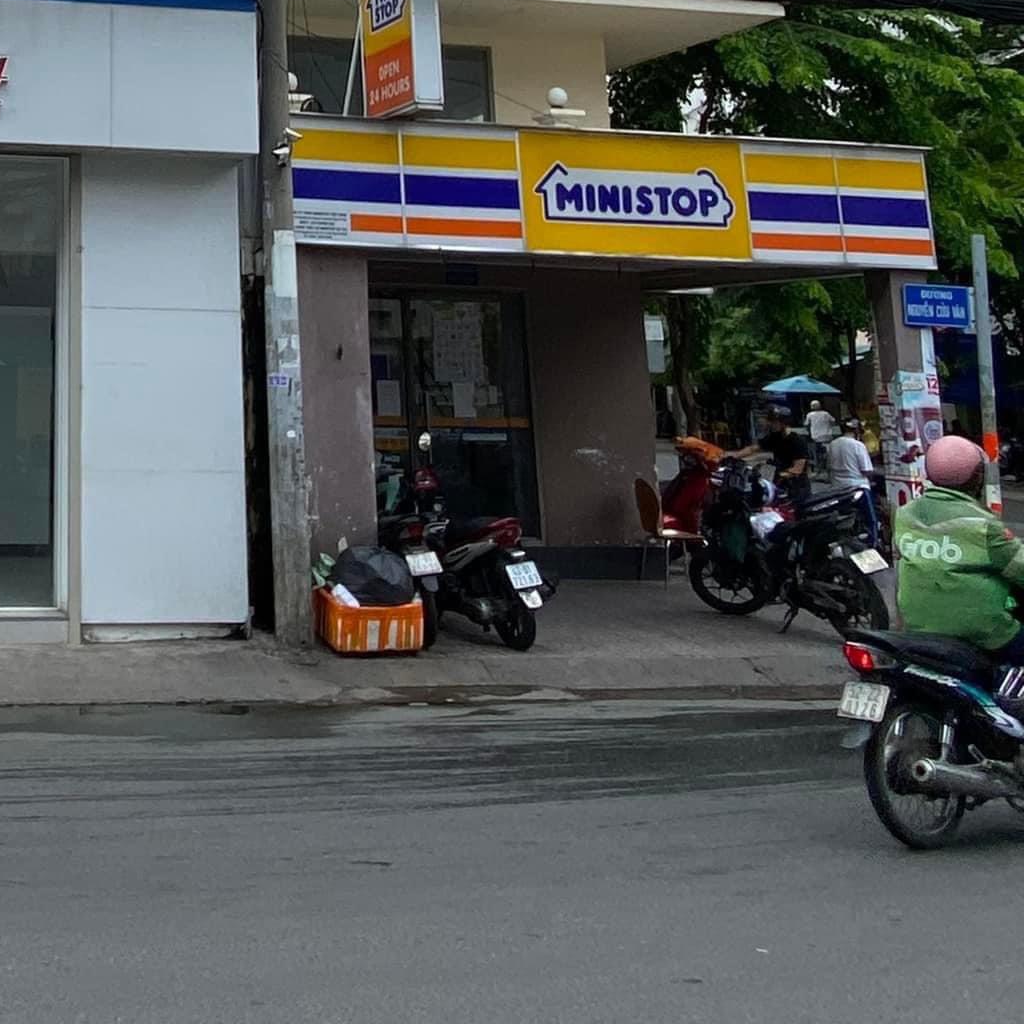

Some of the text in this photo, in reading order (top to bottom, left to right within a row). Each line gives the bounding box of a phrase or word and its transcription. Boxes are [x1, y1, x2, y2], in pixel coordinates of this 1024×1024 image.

[378, 59, 400, 81] OPEN
[368, 76, 410, 105] 24 HOURS
[555, 182, 718, 217] MINISTOP
[899, 532, 962, 563] Grab
